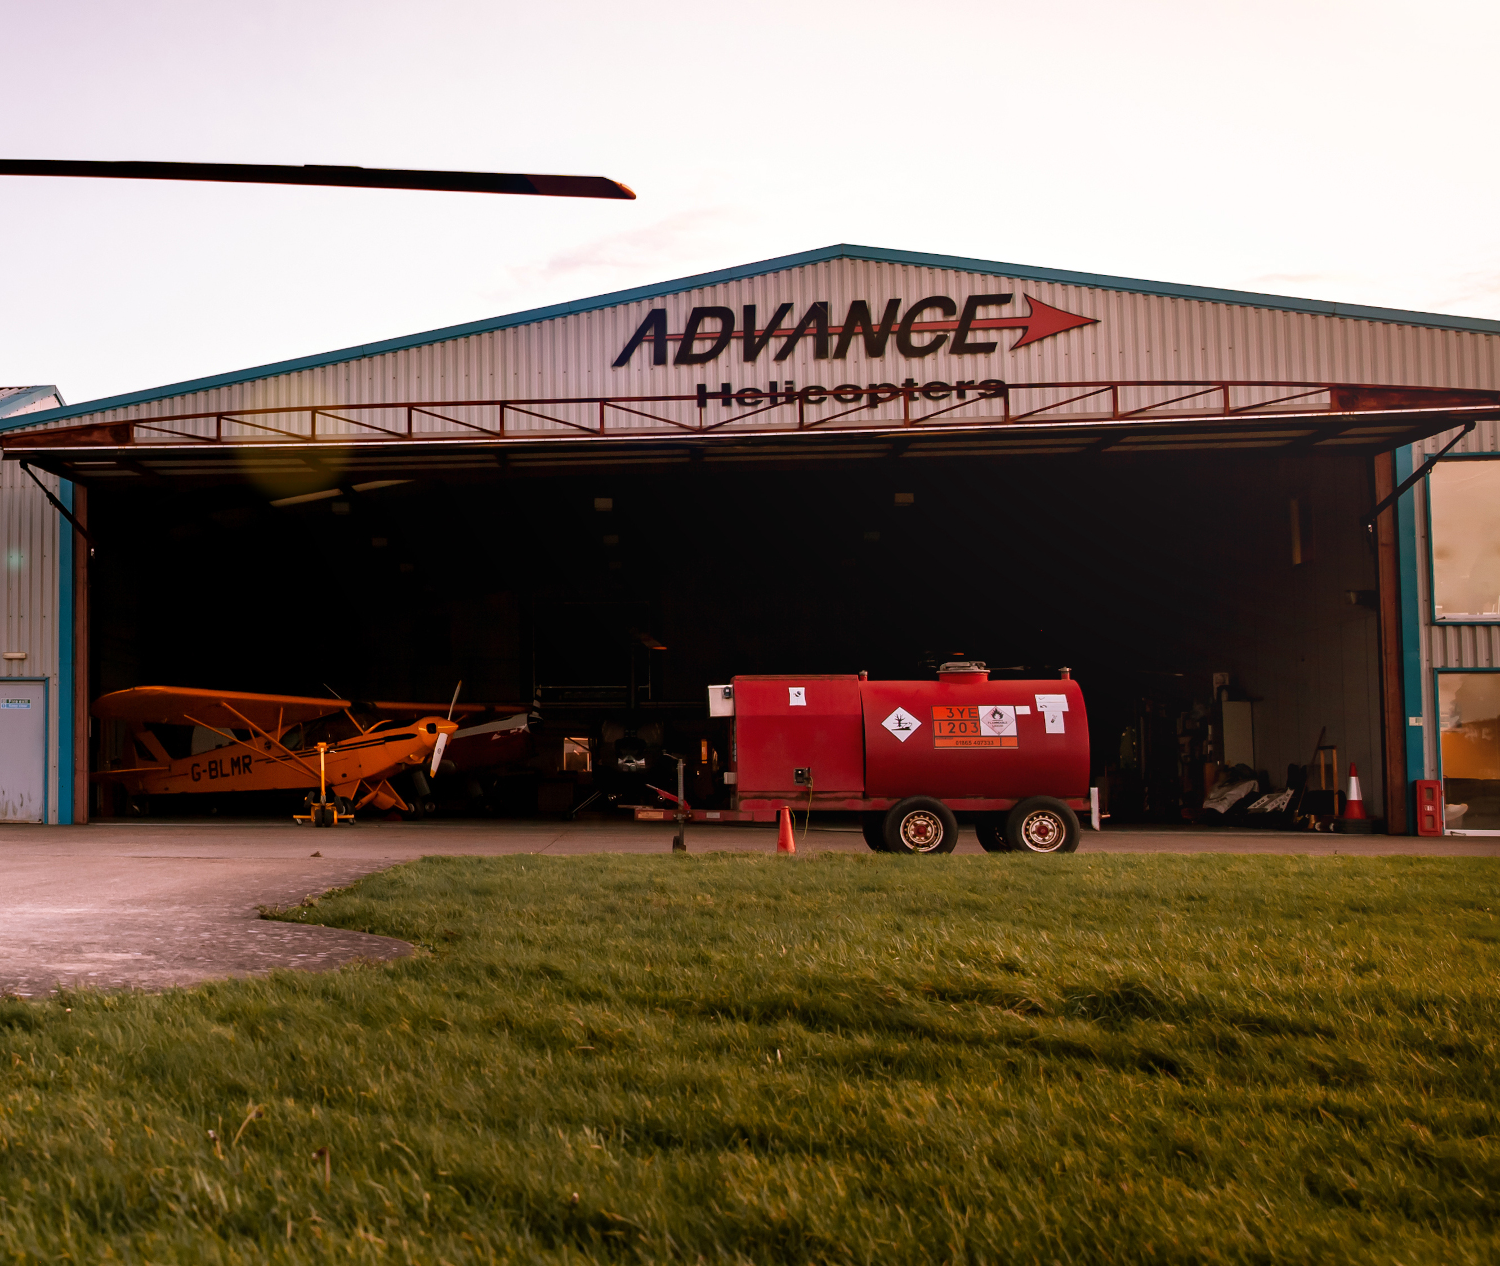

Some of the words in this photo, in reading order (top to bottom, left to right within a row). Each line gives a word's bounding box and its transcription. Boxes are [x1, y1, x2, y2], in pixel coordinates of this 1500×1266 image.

[611, 293, 1014, 367] ADVANCE
[696, 378, 1006, 408] Helicopters
[945, 707, 978, 719] 3YE
[938, 722, 979, 734] 1203
[191, 754, 252, 782] G-BLMR
